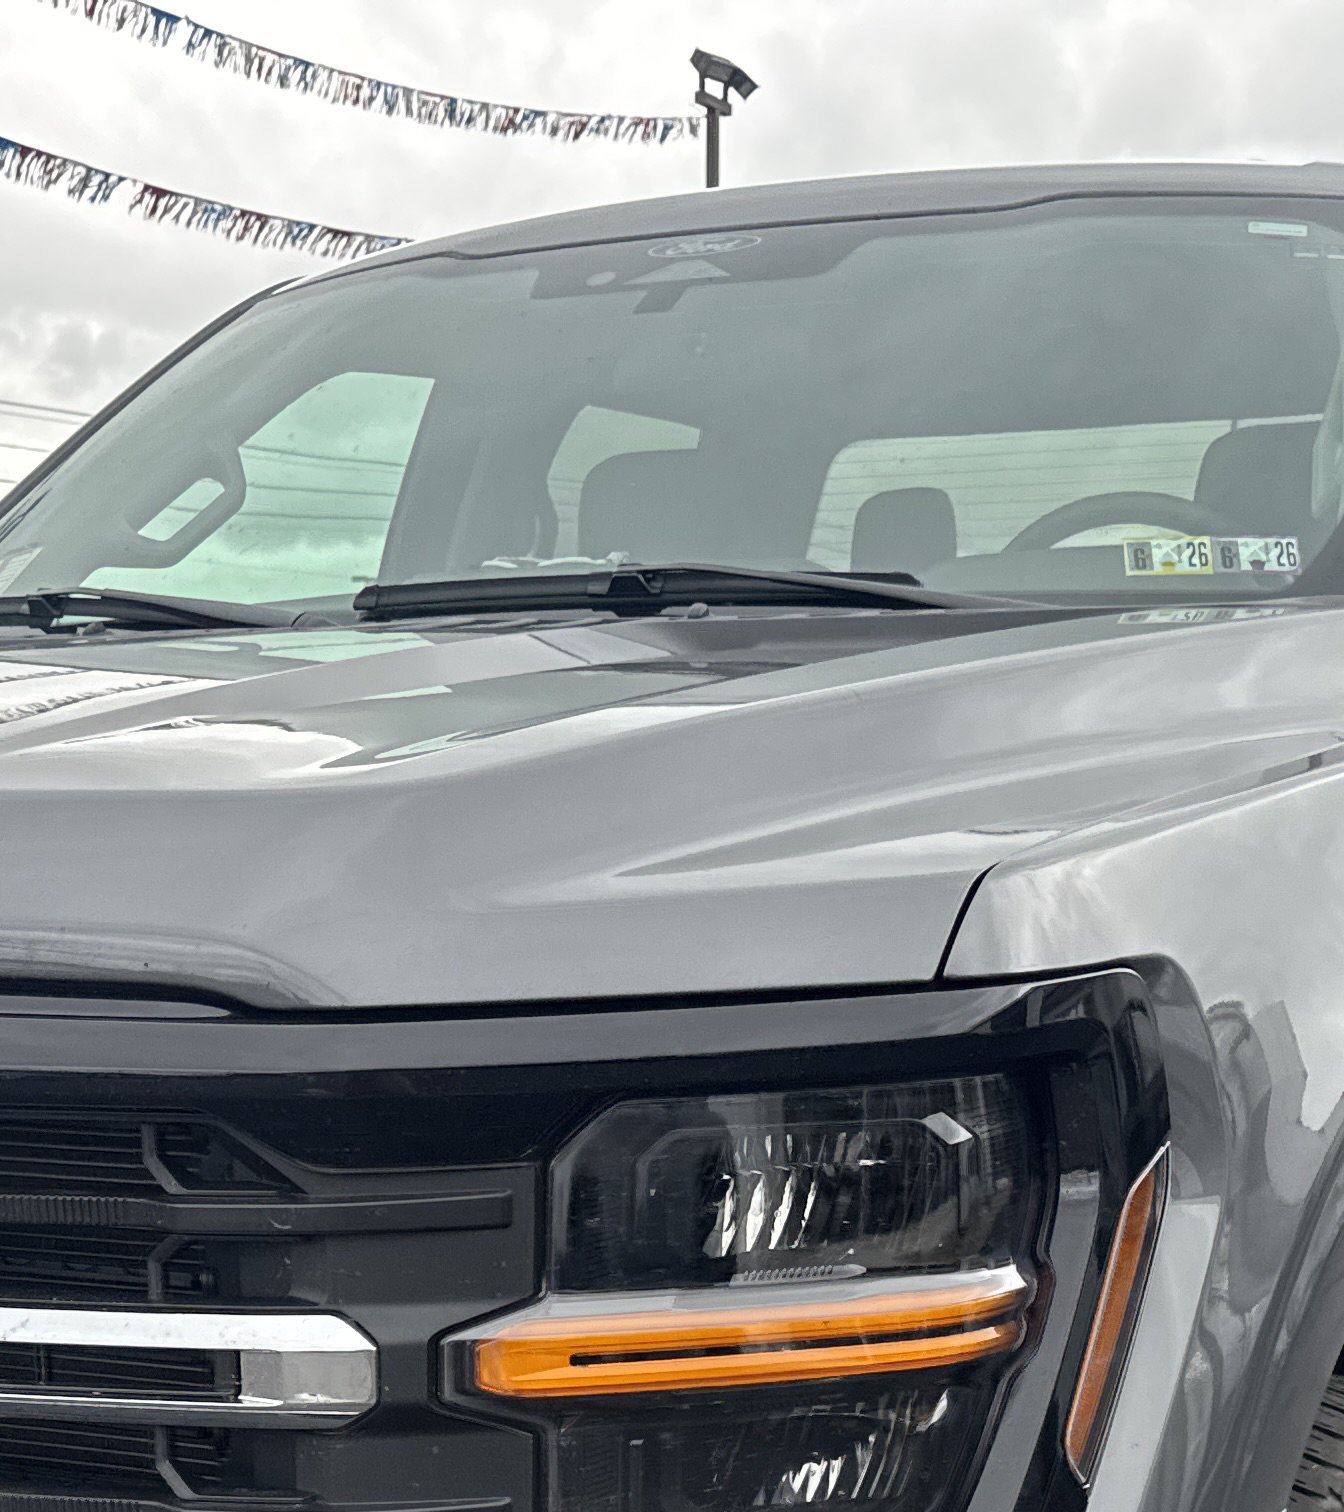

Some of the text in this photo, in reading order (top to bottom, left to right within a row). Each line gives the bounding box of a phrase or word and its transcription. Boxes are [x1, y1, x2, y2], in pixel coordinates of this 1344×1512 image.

[1133, 541, 1209, 570] 6 26
[1220, 540, 1297, 569] 6 26
